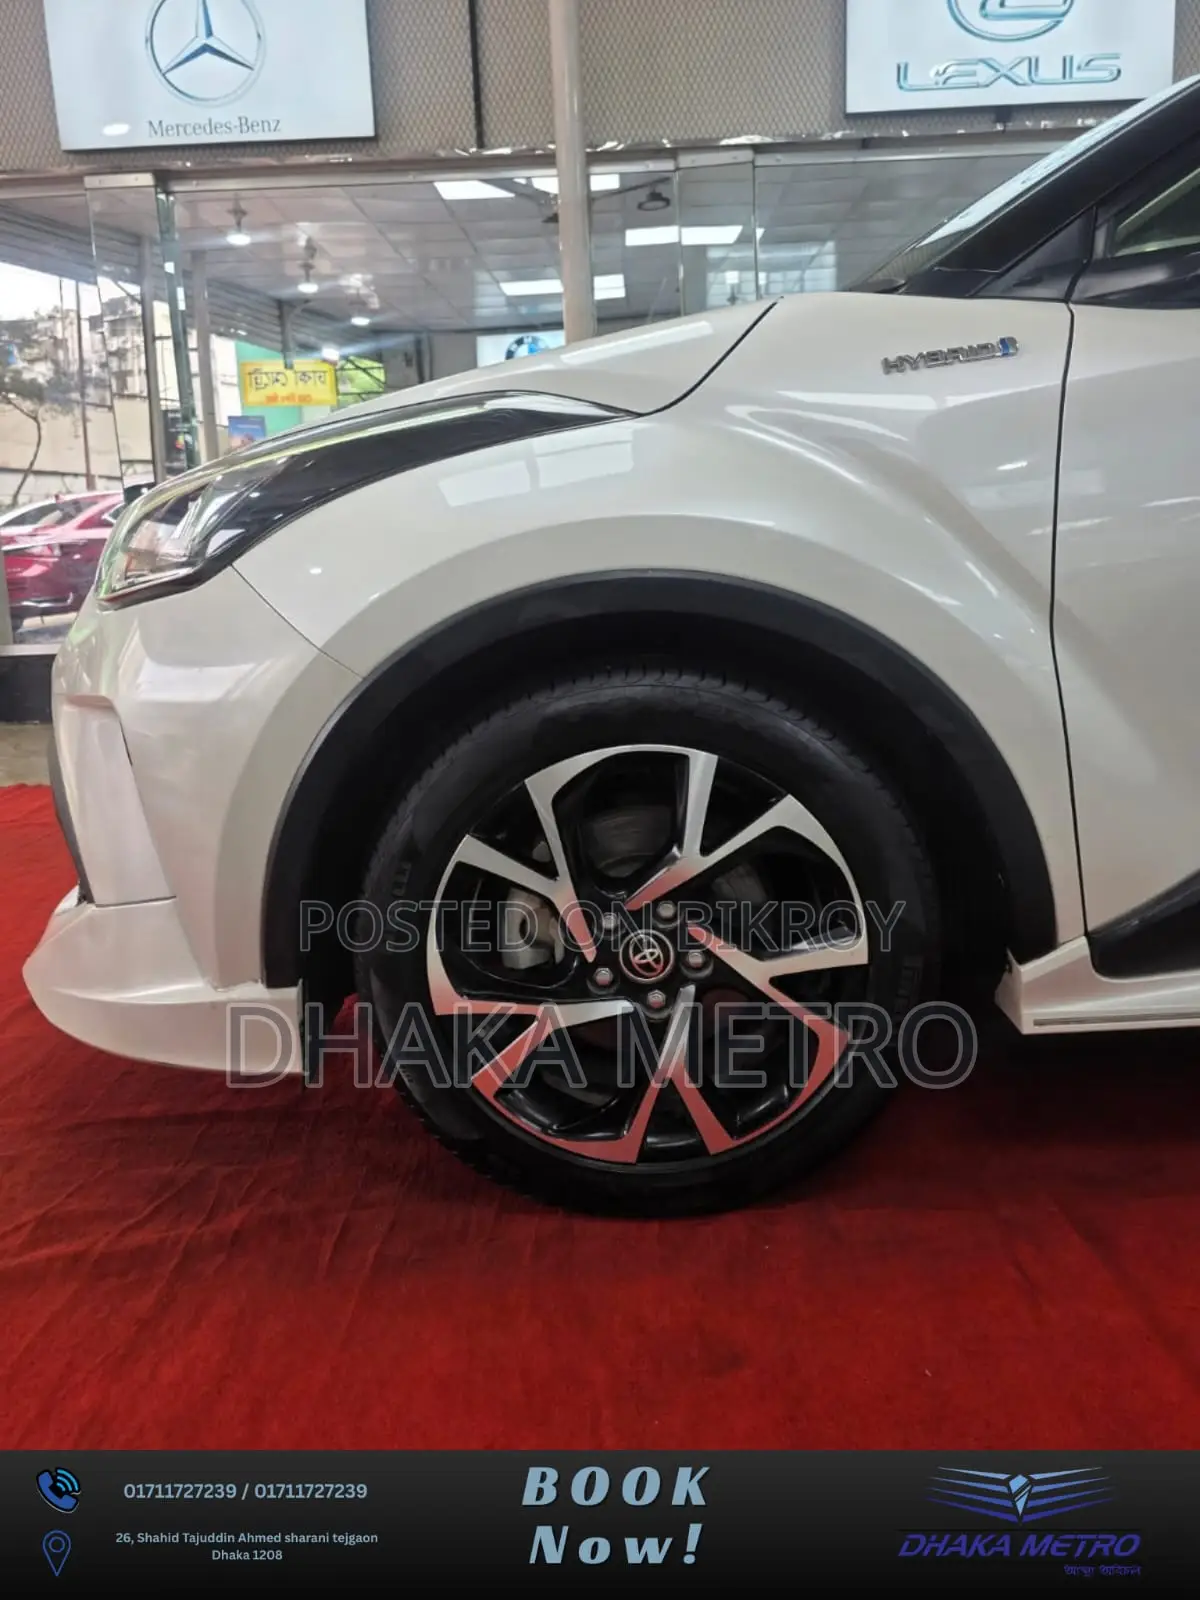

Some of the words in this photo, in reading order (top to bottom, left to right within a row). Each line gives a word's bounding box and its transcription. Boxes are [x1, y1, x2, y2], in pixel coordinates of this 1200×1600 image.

[896, 52, 1121, 92] LEXUS
[148, 115, 281, 138] Mercedes-Benz
[881, 342, 996, 375] HYBRID
